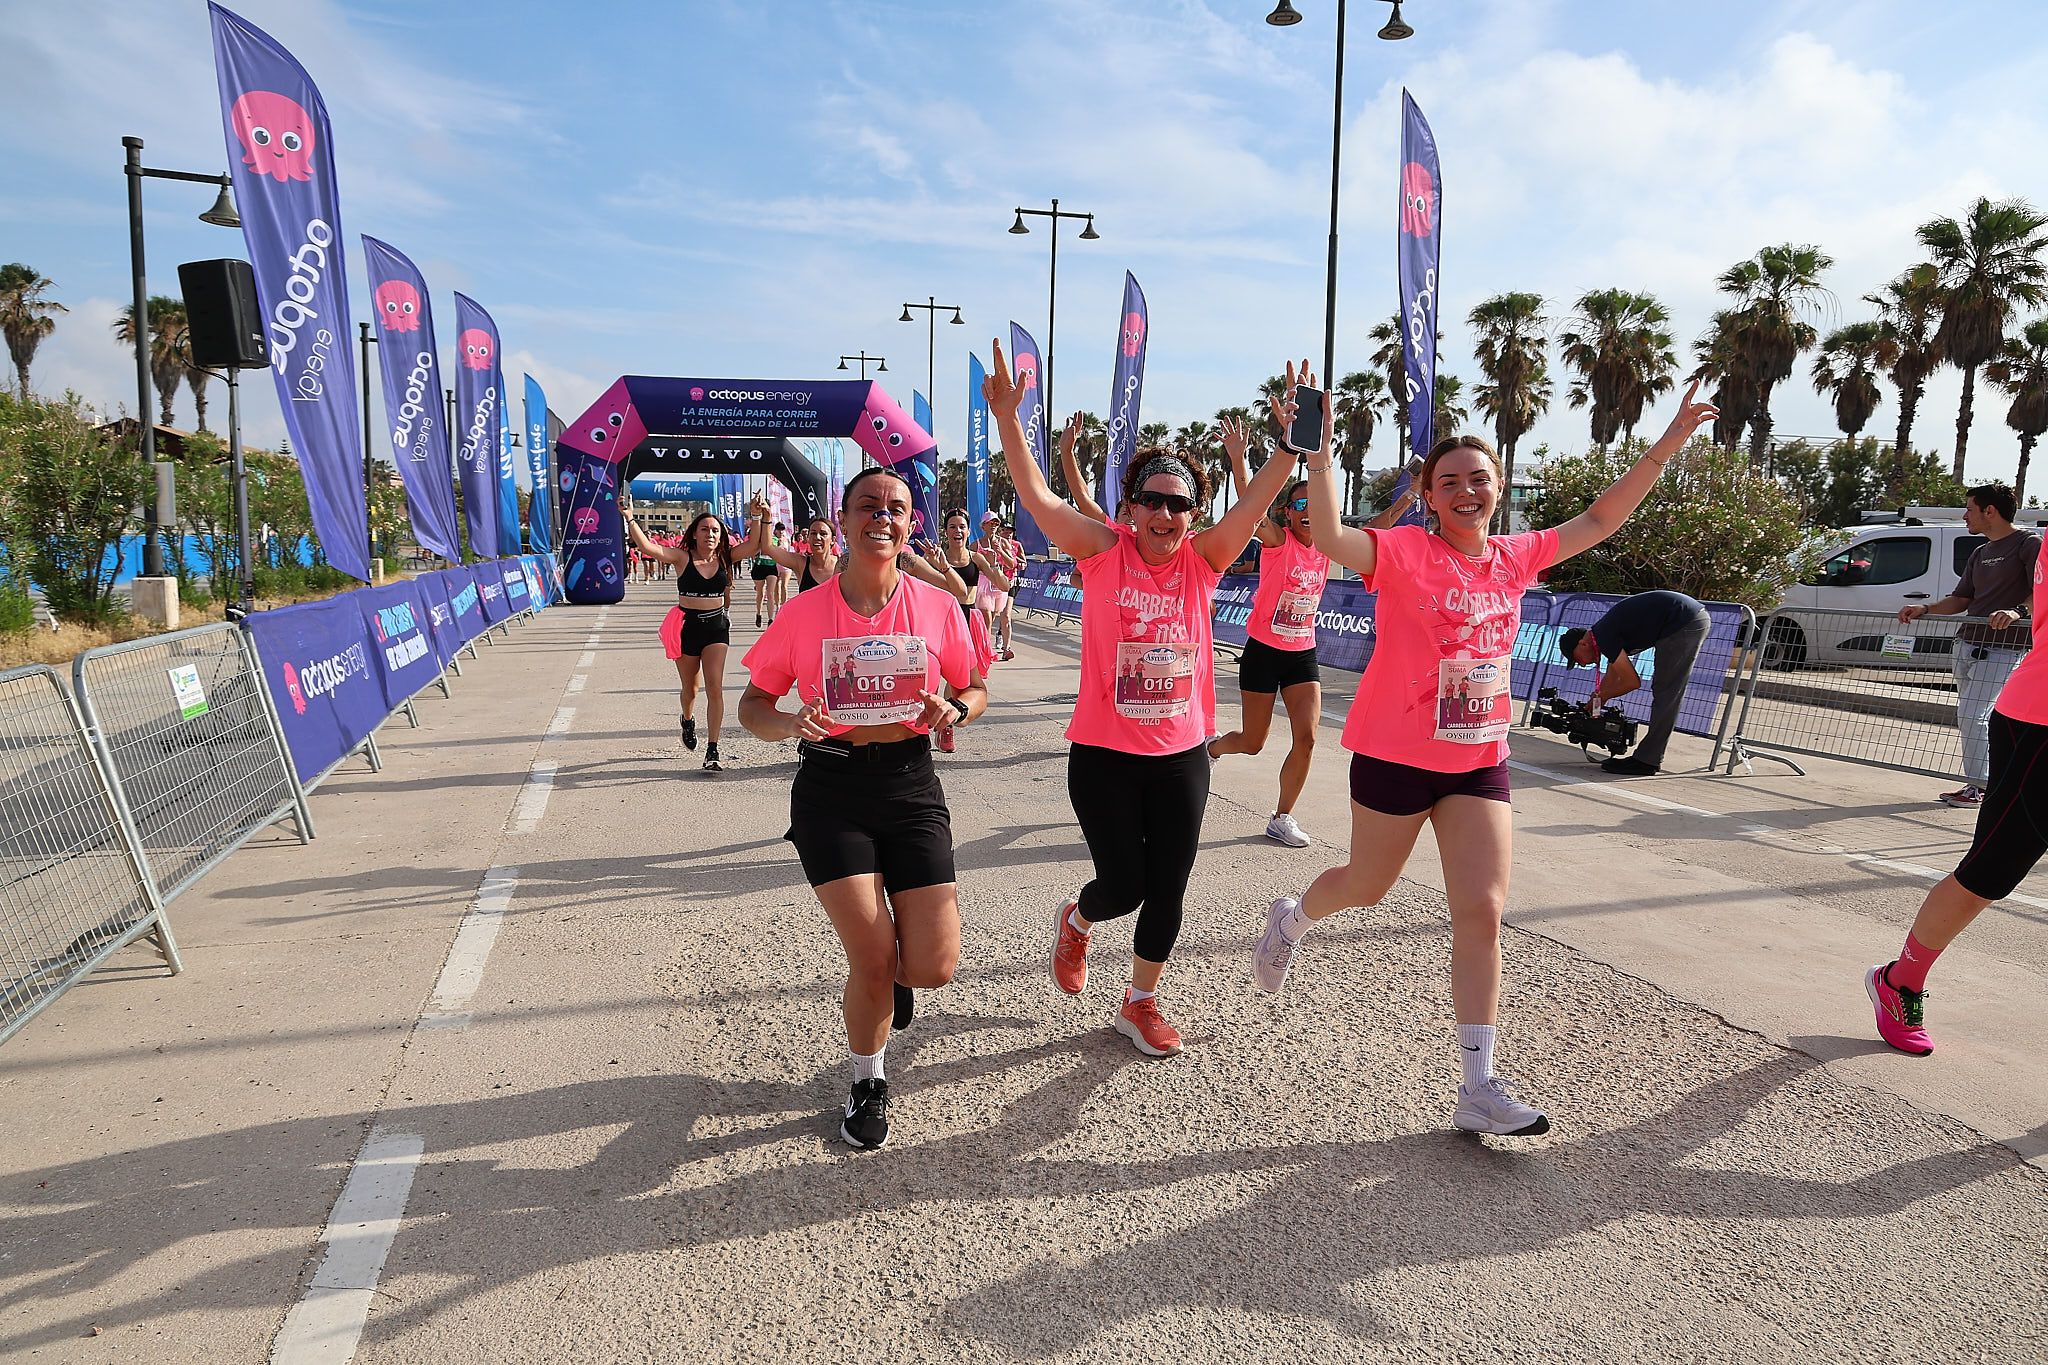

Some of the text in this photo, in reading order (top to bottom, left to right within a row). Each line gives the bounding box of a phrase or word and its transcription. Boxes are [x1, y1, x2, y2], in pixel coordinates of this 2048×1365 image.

[709, 389, 812, 406] octopus energy
[682, 406, 817, 419] LA ENERGÍA PARA CORRER
[680, 418, 688, 426] A
[707, 419, 765, 427] VELOCIDAD
[768, 420, 782, 428] DE
[784, 420, 797, 428] LA
[651, 447, 762, 460] VOLVO
[1291, 613, 1306, 621] 016
[1314, 609, 1372, 637] octopus
[832, 645, 850, 653] SUMA
[857, 649, 894, 657] ASTURIANA
[857, 675, 896, 691] 016
[1144, 678, 1174, 691] 016
[1468, 697, 1495, 712] 016
[839, 712, 869, 720] OYSHO
